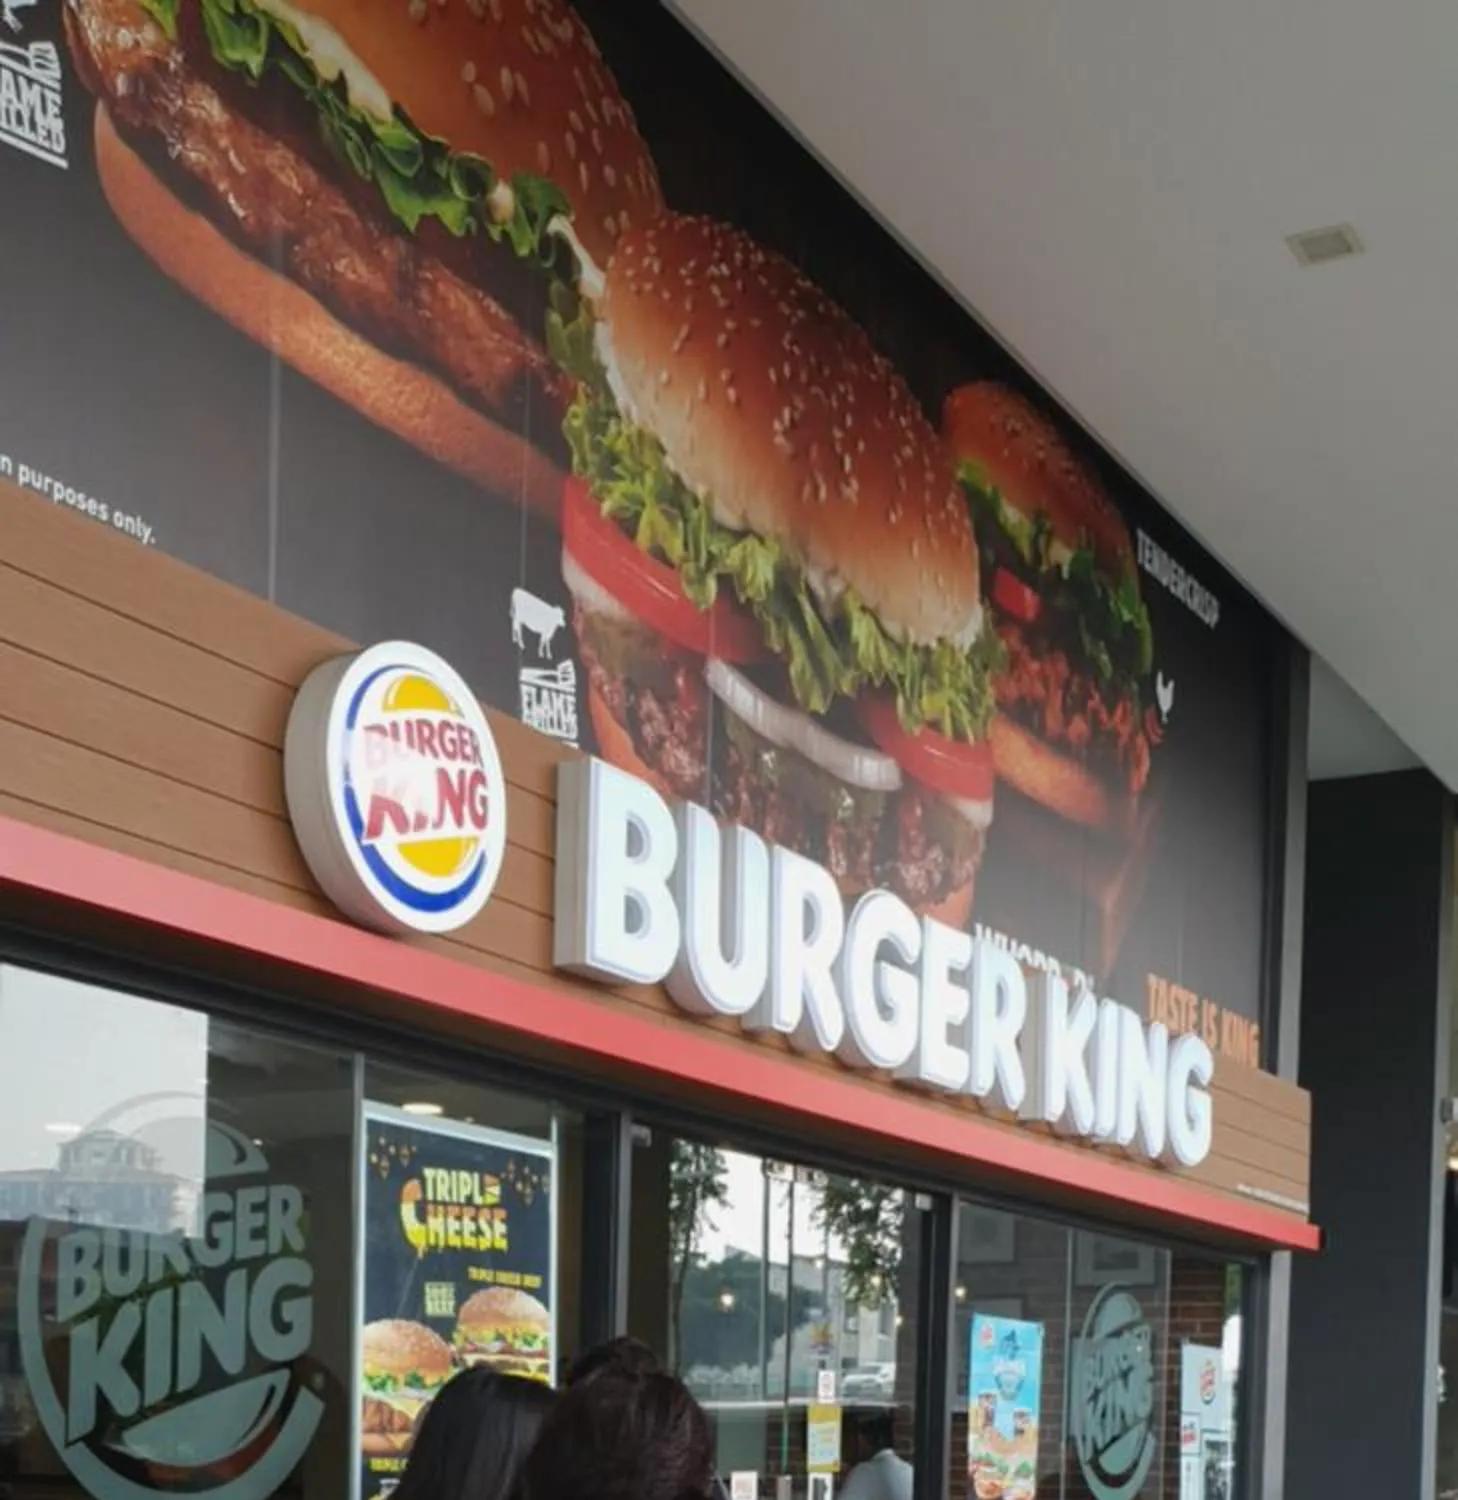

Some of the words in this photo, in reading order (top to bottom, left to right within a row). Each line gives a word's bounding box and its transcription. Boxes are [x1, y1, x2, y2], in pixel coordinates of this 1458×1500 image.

[18, 463, 109, 521] purposes
[113, 509, 156, 545] only.
[586, 755, 1027, 1113] BURGER
[1041, 974, 1213, 1168] KING
[1147, 972, 1199, 1034] TASTE
[1202, 997, 1218, 1048] IS
[58, 1184, 305, 1323] BURGER
[399, 1178, 508, 1260] CHEESE
[65, 1257, 314, 1448] KING
